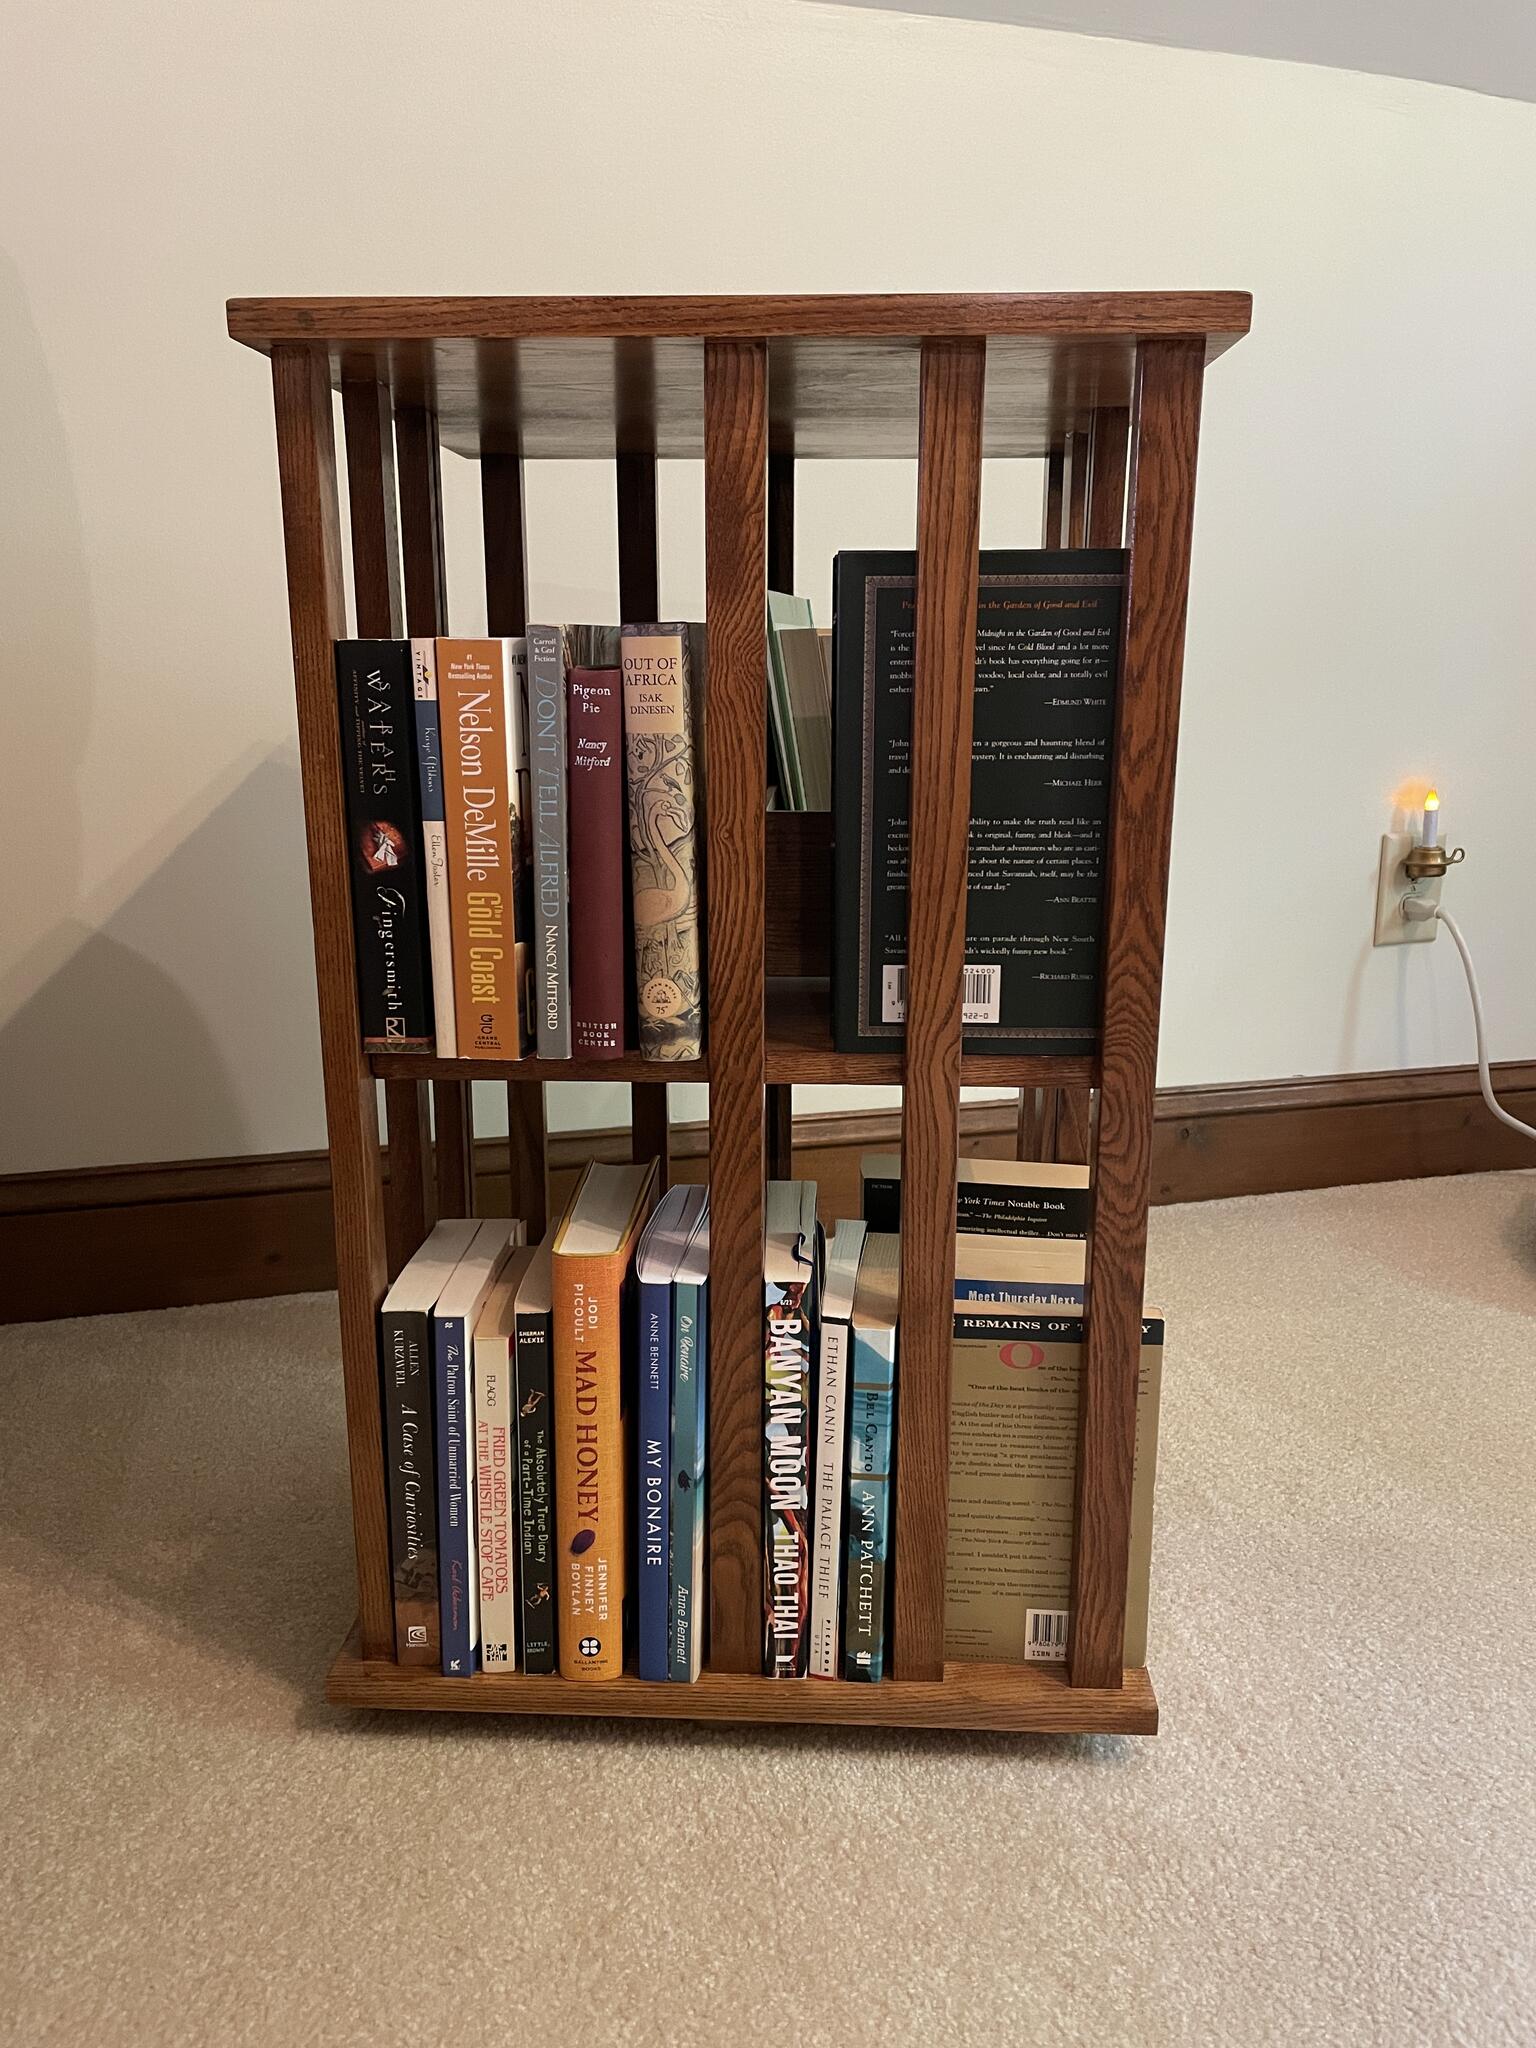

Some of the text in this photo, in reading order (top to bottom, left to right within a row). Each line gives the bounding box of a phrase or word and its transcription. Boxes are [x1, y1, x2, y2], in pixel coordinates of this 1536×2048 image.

[1003, 601, 1032, 610] Garden
[977, 629, 1081, 638] Midnight Garden Good
[1018, 643, 1070, 651] Cold Blood and
[448, 672, 475, 681] Bestselling
[624, 657, 678, 671] OUT OF
[989, 657, 1058, 666] book everything
[1070, 670, 1092, 679] totally
[573, 684, 611, 700] Pigeon
[625, 674, 677, 686] AFRICA
[639, 693, 663, 702] ISAK
[583, 703, 600, 713] Pie
[630, 705, 675, 715] DINESEN
[577, 738, 607, 753] Nancy
[1014, 753, 1053, 761] enchanting
[1055, 752, 1068, 760] and
[1040, 739, 1072, 747] haunting
[574, 755, 611, 771] Mitford
[457, 690, 500, 882] Nelson DeMille
[536, 675, 561, 917] DON'T TELL ALFRED
[431, 834, 442, 858] Ellen
[467, 891, 503, 939] Gold
[376, 886, 406, 1011] Fingersmith
[993, 935, 1017, 943] parade
[1020, 935, 1050, 943] through
[469, 947, 504, 1004] Coast
[545, 925, 560, 1030] NANCY MITFORD
[577, 1021, 617, 1029] BRITISH
[578, 1039, 616, 1047] CENTRE
[964, 1197, 1066, 1210] York Times Notable Book
[573, 1283, 584, 1343] PICOULT
[588, 1297, 598, 1329] JODI
[968, 1290, 995, 1301] Meet
[999, 1291, 1047, 1304] Thursday
[680, 1315, 693, 1334] On
[963, 1319, 1071, 1331] REMAINS OF
[393, 1330, 406, 1388] KURZWEIL
[408, 1340, 419, 1376] ALLEN
[649, 1313, 659, 1390] ANNE BENNETT
[770, 1319, 801, 1424] BANYAN
[486, 1375, 496, 1407] FLAGG
[446, 1344, 462, 1527] The Patron Saint of Unmarried Women
[524, 1439, 531, 1449] of
[575, 1350, 599, 1523] MAD HONEY
[864, 1392, 878, 1472] BEL CANTO
[399, 1403, 423, 1560] A Case of Curiosities
[769, 1435, 801, 1510] MOON
[818, 1336, 838, 1599] ETHAN CANIN THE PALACE THIEF
[522, 1457, 534, 1517] Part-Time
[533, 1430, 549, 1563] The Absolutely True Diary
[646, 1439, 662, 1566] MY BONAIRE
[478, 1420, 494, 1602] AT THE WHISTLE STOP CAFE
[493, 1427, 508, 1594] FRIED GREEN TOMATOES
[523, 1519, 535, 1555] Indian
[773, 1532, 799, 1585] THAO
[858, 1490, 875, 1637] ANN PATCHETT
[571, 1563, 581, 1616] BOYLAN
[584, 1566, 595, 1614] FINNEY
[598, 1557, 608, 1621] JENNIFER
[676, 1584, 689, 1665] Anne Bennett
[773, 1592, 799, 1639] THAI
